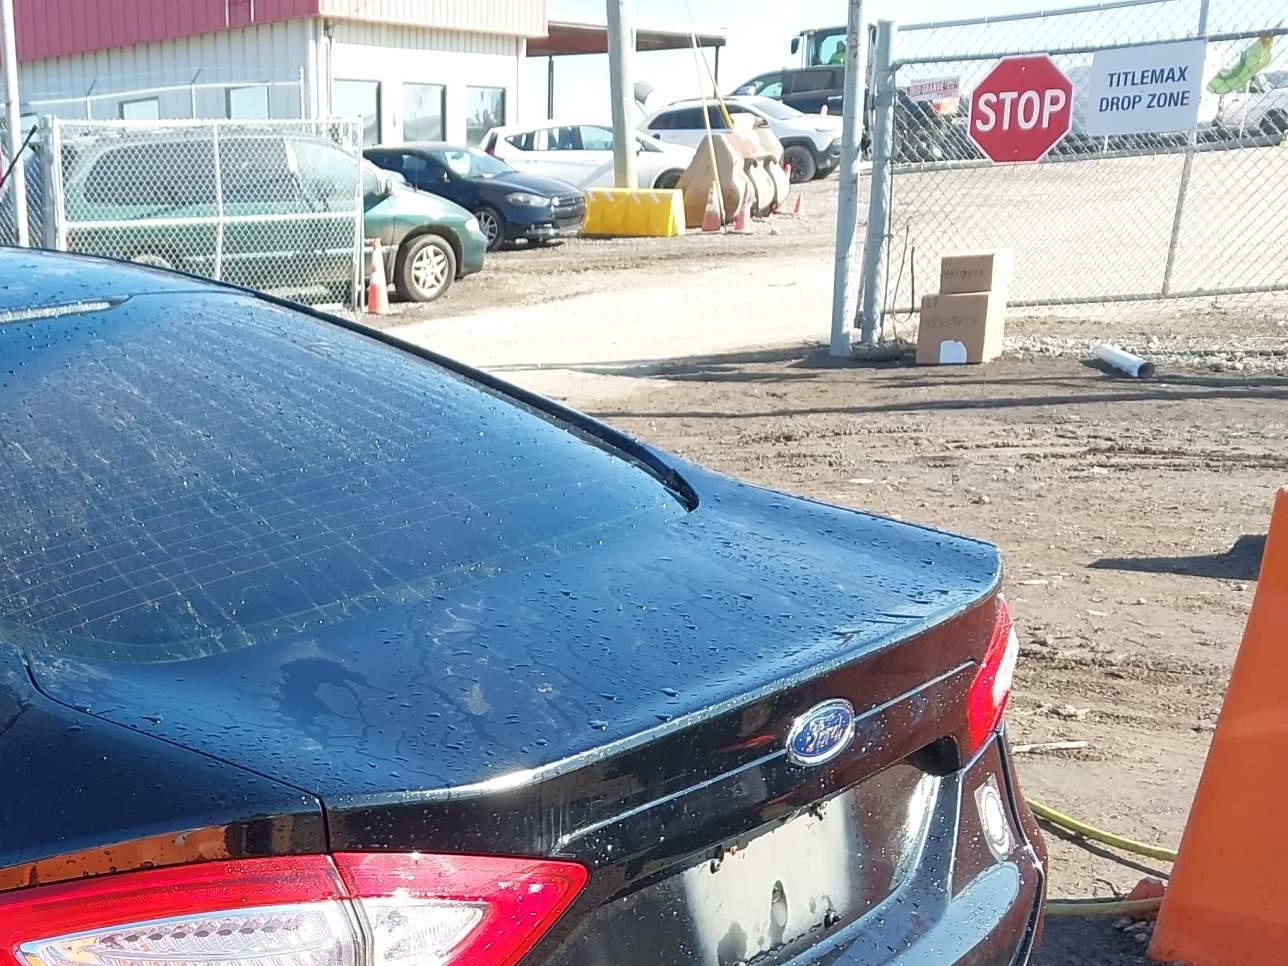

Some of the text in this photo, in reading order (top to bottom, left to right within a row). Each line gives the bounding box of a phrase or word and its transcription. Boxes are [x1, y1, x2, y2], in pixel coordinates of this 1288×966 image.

[1107, 65, 1188, 88] TITLEMAX
[975, 88, 1066, 132] STOP
[1098, 90, 1191, 113] DROP ZONE
